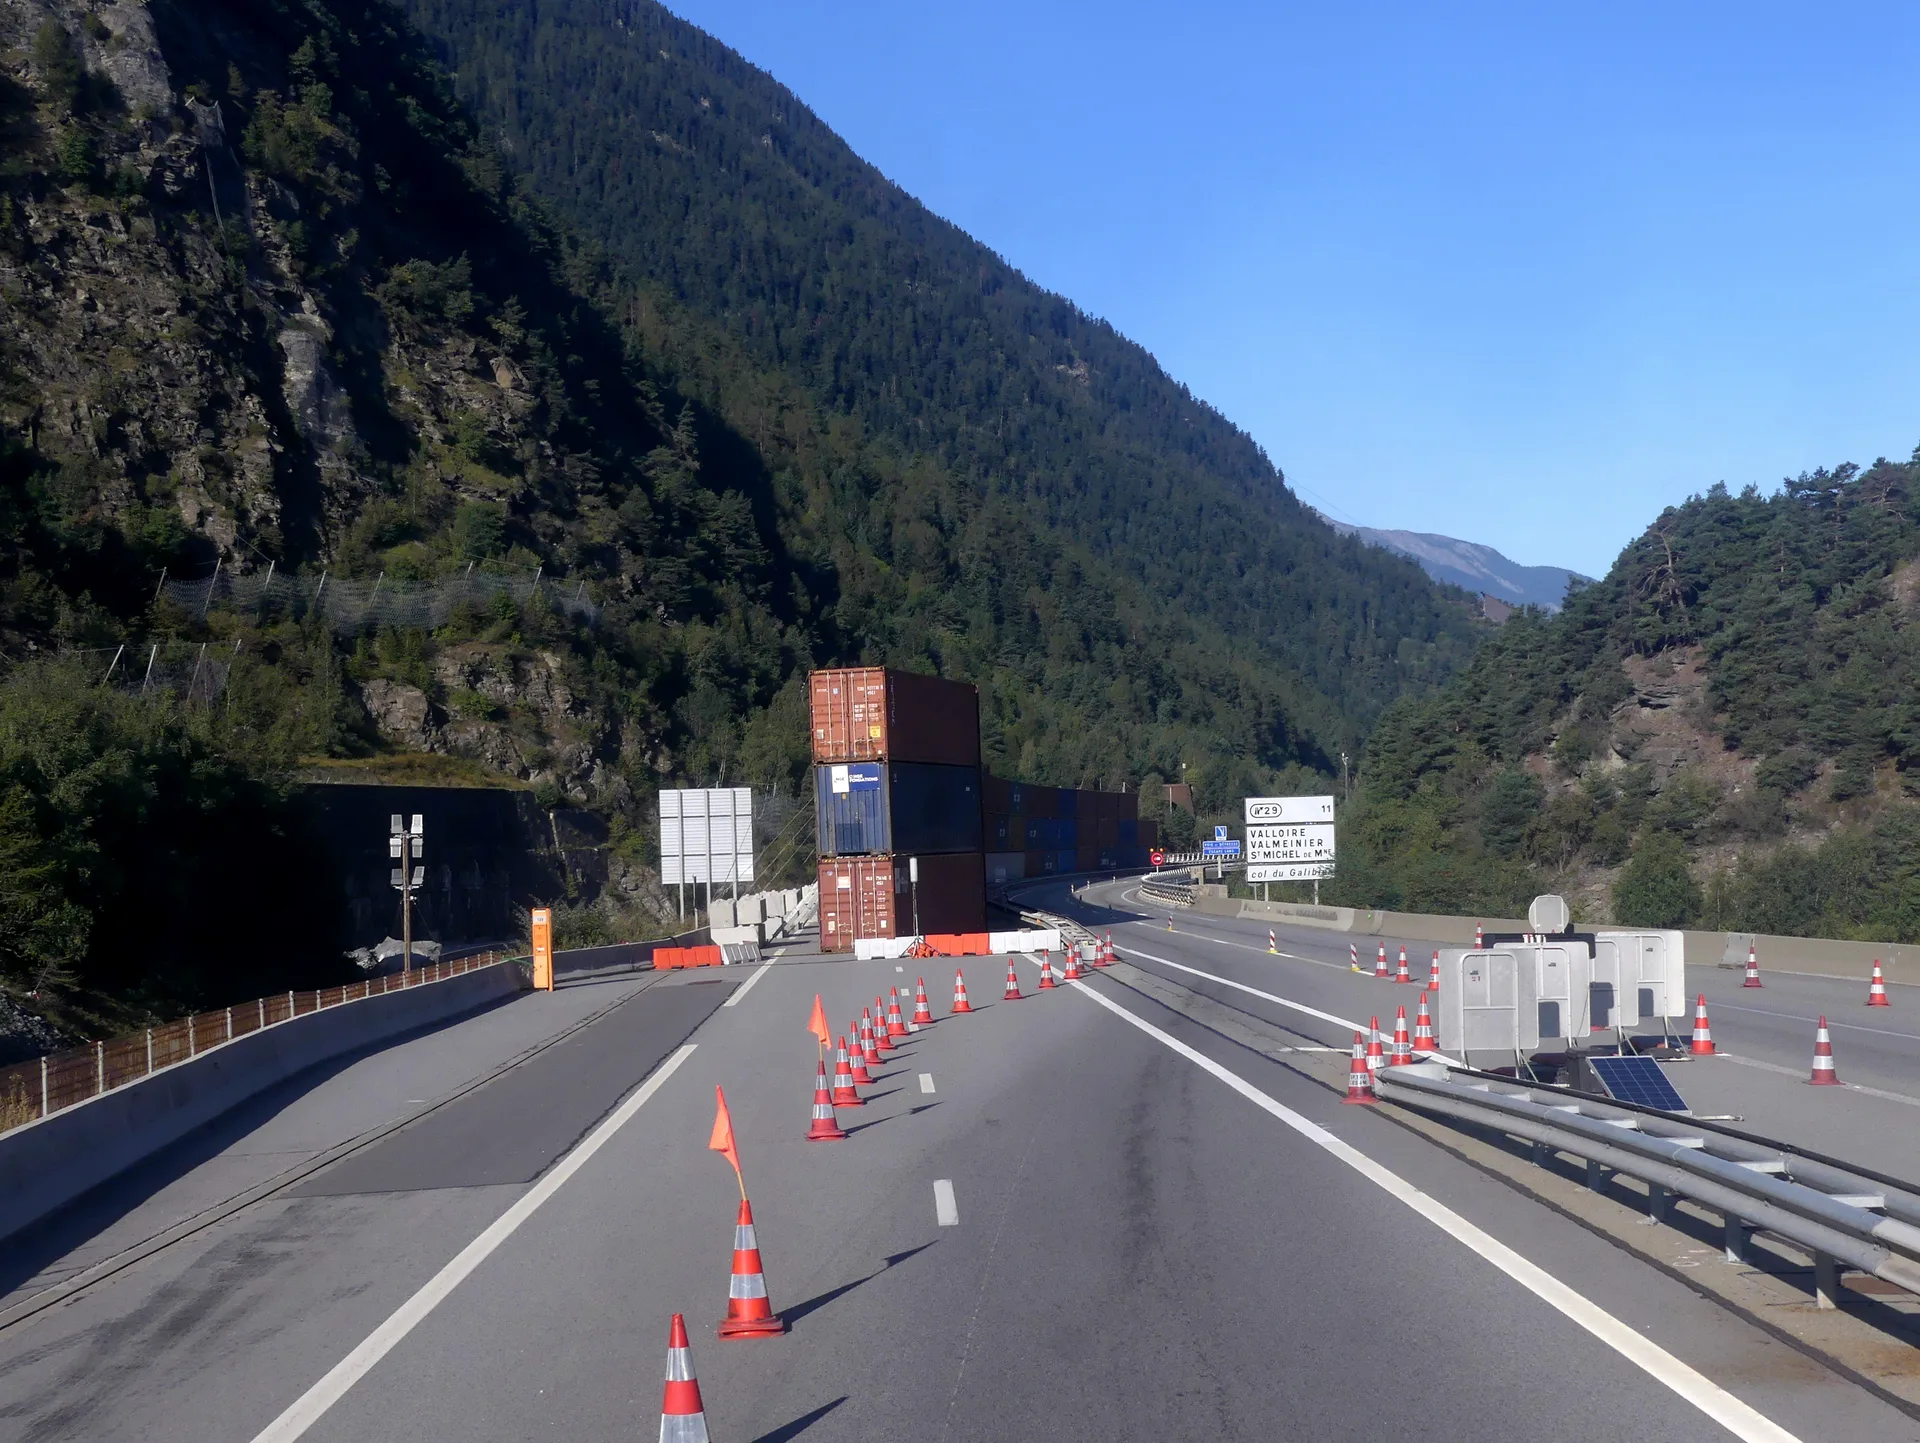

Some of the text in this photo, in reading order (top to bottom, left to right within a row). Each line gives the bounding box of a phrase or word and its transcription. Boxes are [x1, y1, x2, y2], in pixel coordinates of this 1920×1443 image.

[1264, 806, 1278, 815] 29
[1321, 805, 1331, 813] 11
[1250, 828, 1306, 838] VALLOIRE
[1250, 838, 1324, 848] VALMEINIER
[1263, 850, 1300, 859] MICHEL
[1251, 868, 1332, 878] col du Galibi
